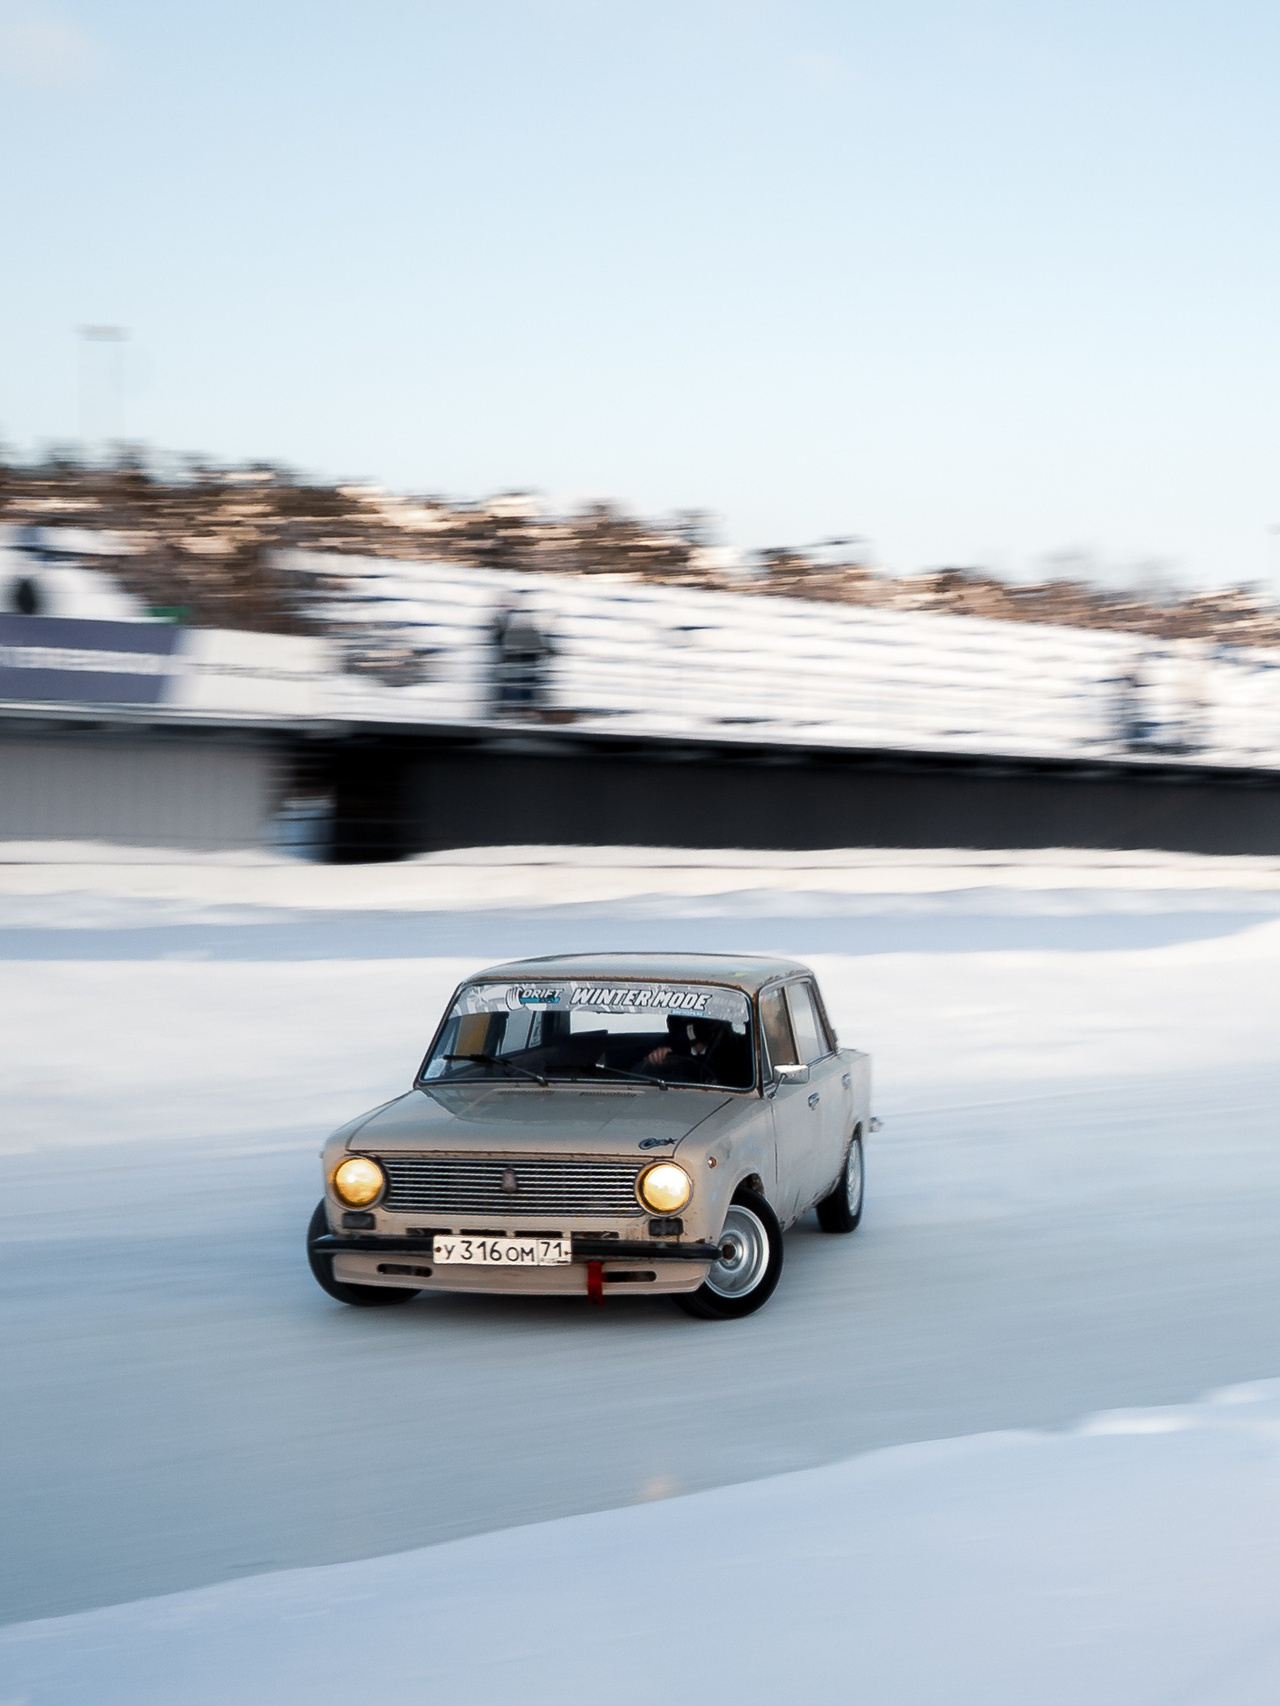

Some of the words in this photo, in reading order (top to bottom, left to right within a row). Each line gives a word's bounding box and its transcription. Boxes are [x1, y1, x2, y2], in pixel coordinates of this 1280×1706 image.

[521, 988, 563, 999] DRIFT
[570, 988, 653, 1007] WINTER
[651, 990, 713, 1011] MODE
